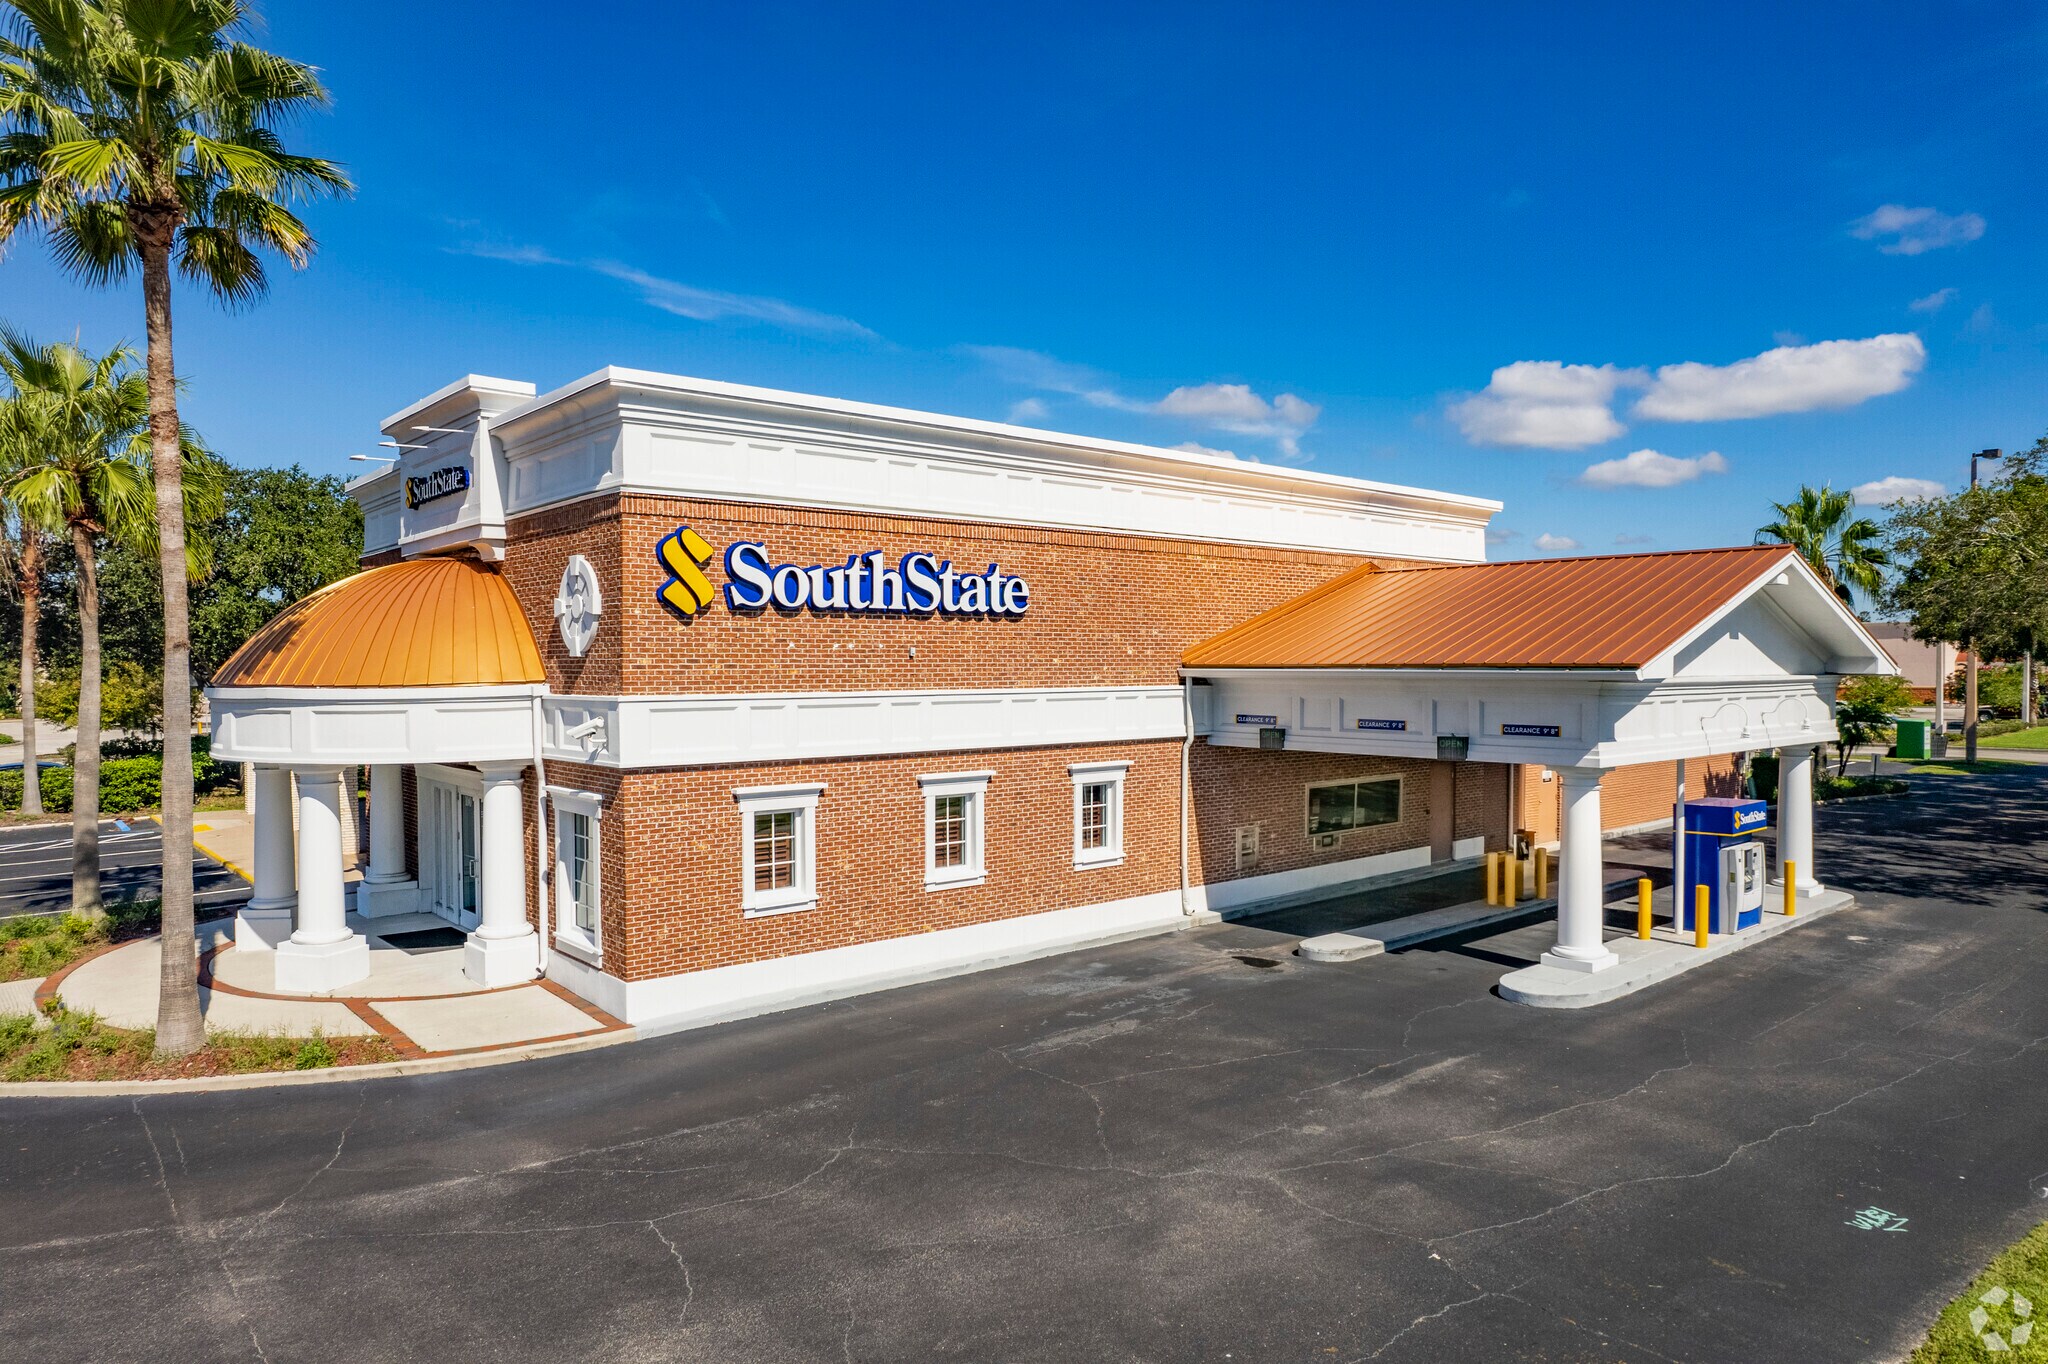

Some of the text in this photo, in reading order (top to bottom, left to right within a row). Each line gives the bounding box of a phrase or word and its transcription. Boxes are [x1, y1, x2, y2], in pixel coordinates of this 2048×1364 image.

[412, 468, 461, 503] SouthState
[725, 542, 1031, 614] SouthState
[1503, 726, 1541, 734] CLEARANCE
[1439, 739, 1463, 748] OPEN
